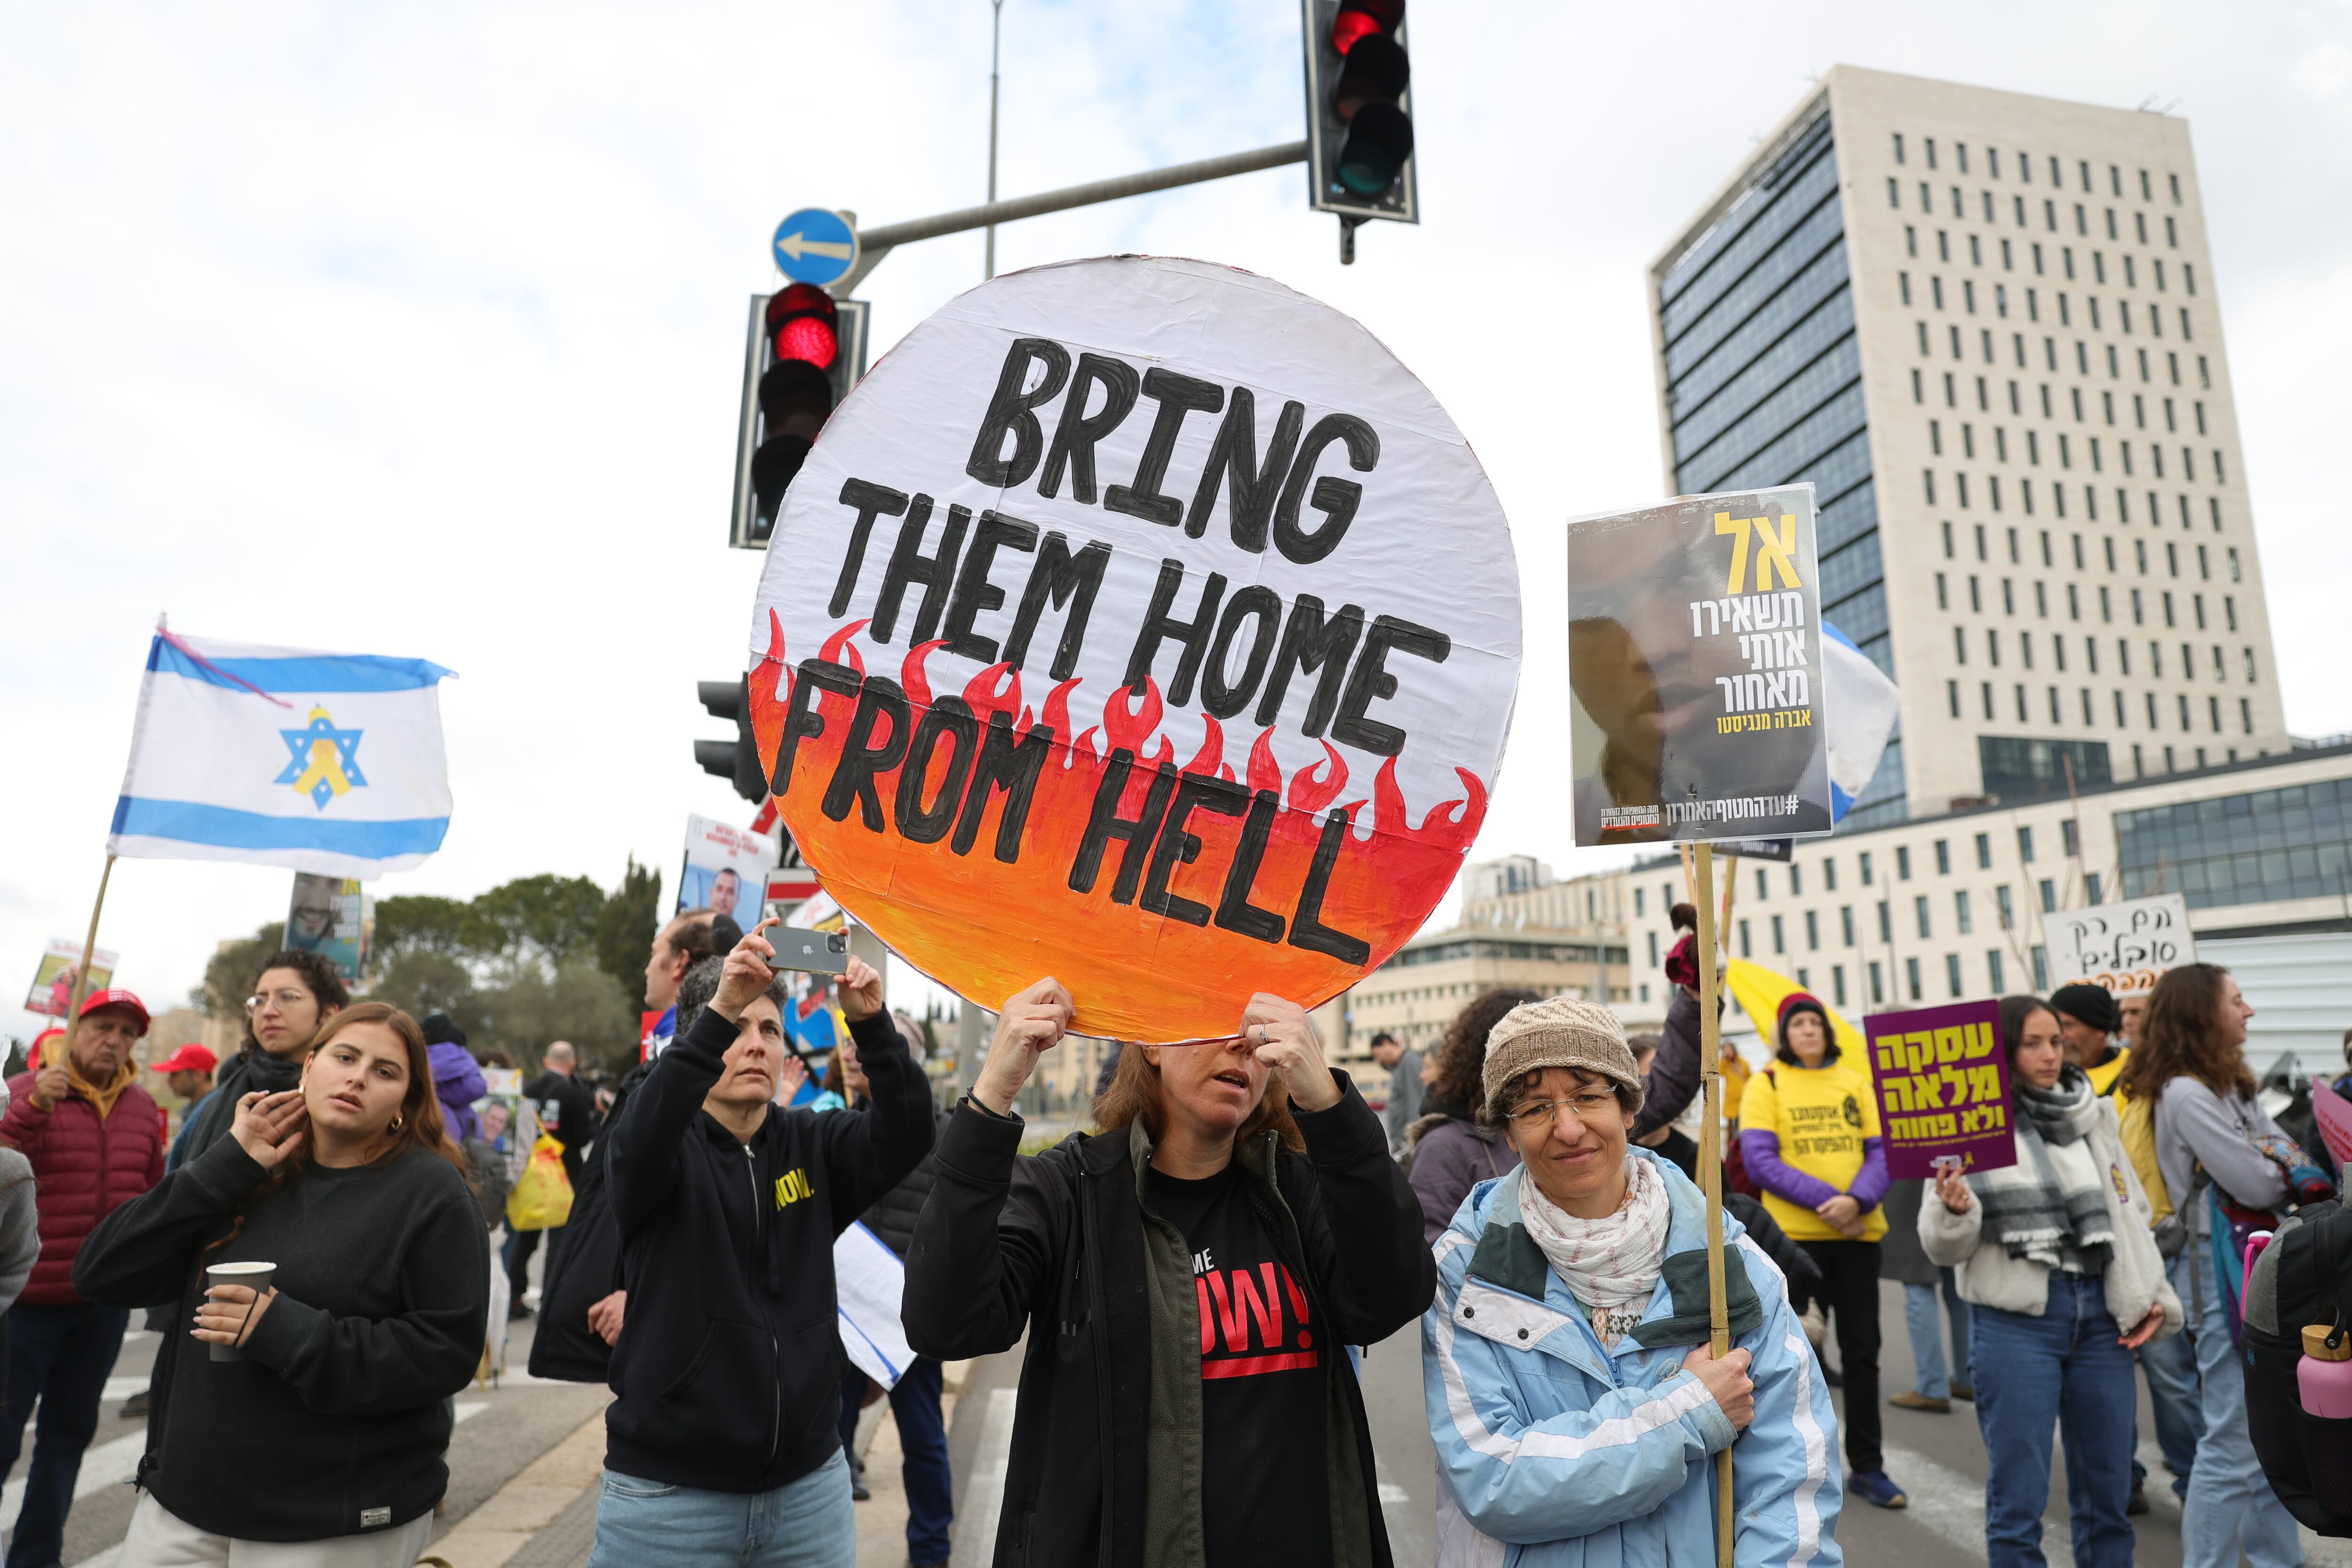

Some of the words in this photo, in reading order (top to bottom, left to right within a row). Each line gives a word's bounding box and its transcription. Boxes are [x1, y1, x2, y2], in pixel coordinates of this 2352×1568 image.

[966, 338, 1380, 565] BRING
[1715, 512, 1802, 595] אל
[827, 477, 1113, 681] THEM
[1121, 558, 1451, 756] HOME
[1690, 591, 1804, 637] תשאירו
[1739, 629, 1807, 670] אותי
[1716, 669, 1809, 713] מאחור
[1716, 713, 1771, 734] מנגיסטו
[1775, 710, 1812, 730] אברה
[770, 657, 1054, 864] FROM
[1067, 747, 1371, 967] HELL
[1601, 807, 1621, 817] להחזרת
[1601, 816, 1629, 828] והנעדרים
[1621, 806, 1646, 815] המשפחות
[1631, 814, 1659, 825] החטופים
[1647, 805, 1659, 813] מטה
[2067, 917, 2107, 955] רק
[2131, 906, 2171, 933] הם
[2082, 933, 2177, 975] סובלים
[1875, 1021, 1995, 1074] עסקה
[1882, 1064, 2002, 1113] מלאה
[1888, 1112, 1957, 1140] פחות
[1960, 1105, 2006, 1133] ולא
[775, 1168, 814, 1212] NOW.
